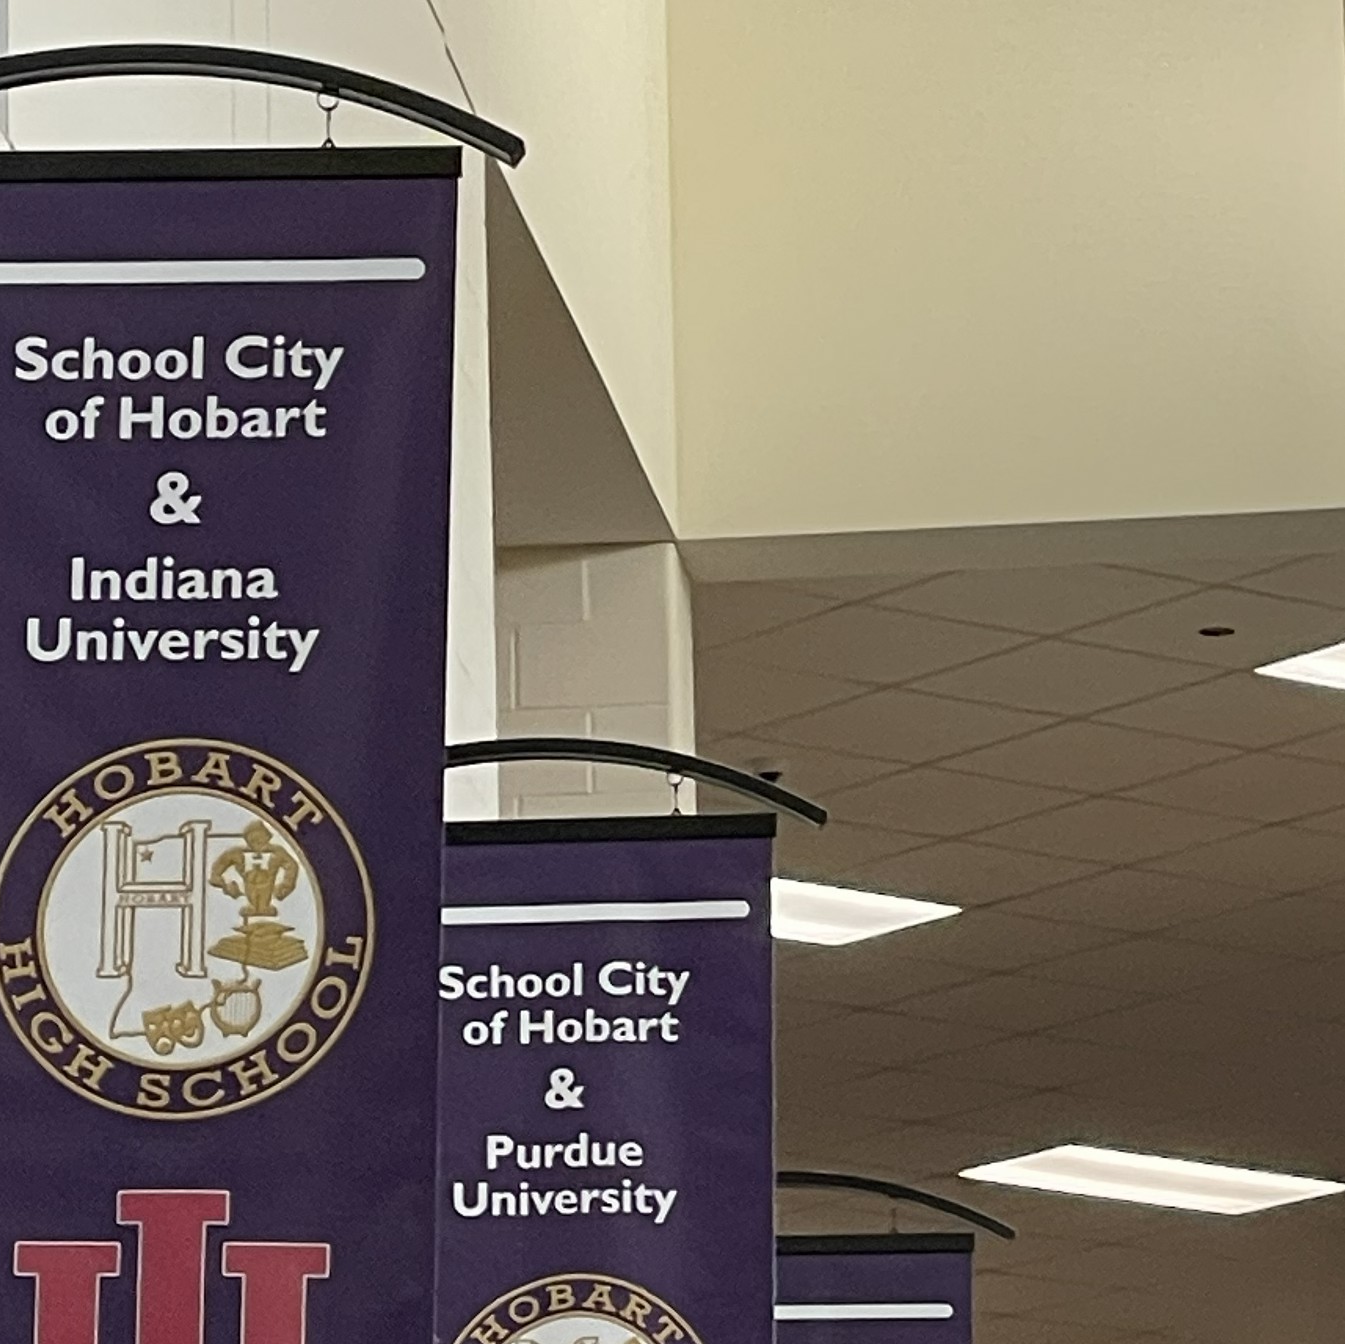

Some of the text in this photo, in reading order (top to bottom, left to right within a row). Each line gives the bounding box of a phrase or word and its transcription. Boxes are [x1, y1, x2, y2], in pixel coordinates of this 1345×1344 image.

[15, 334, 345, 391] School City
[45, 395, 327, 441] of Hobart
[149, 471, 202, 525] &
[71, 555, 279, 601] Indiana
[26, 615, 320, 673] University
[42, 752, 323, 837] HOBART
[438, 960, 690, 1006] School City
[136, 935, 364, 1107] SCHOOL
[462, 1007, 680, 1046] of Hobart
[544, 1067, 585, 1110] &
[486, 1132, 644, 1170] Purdue
[452, 1178, 678, 1225] University
